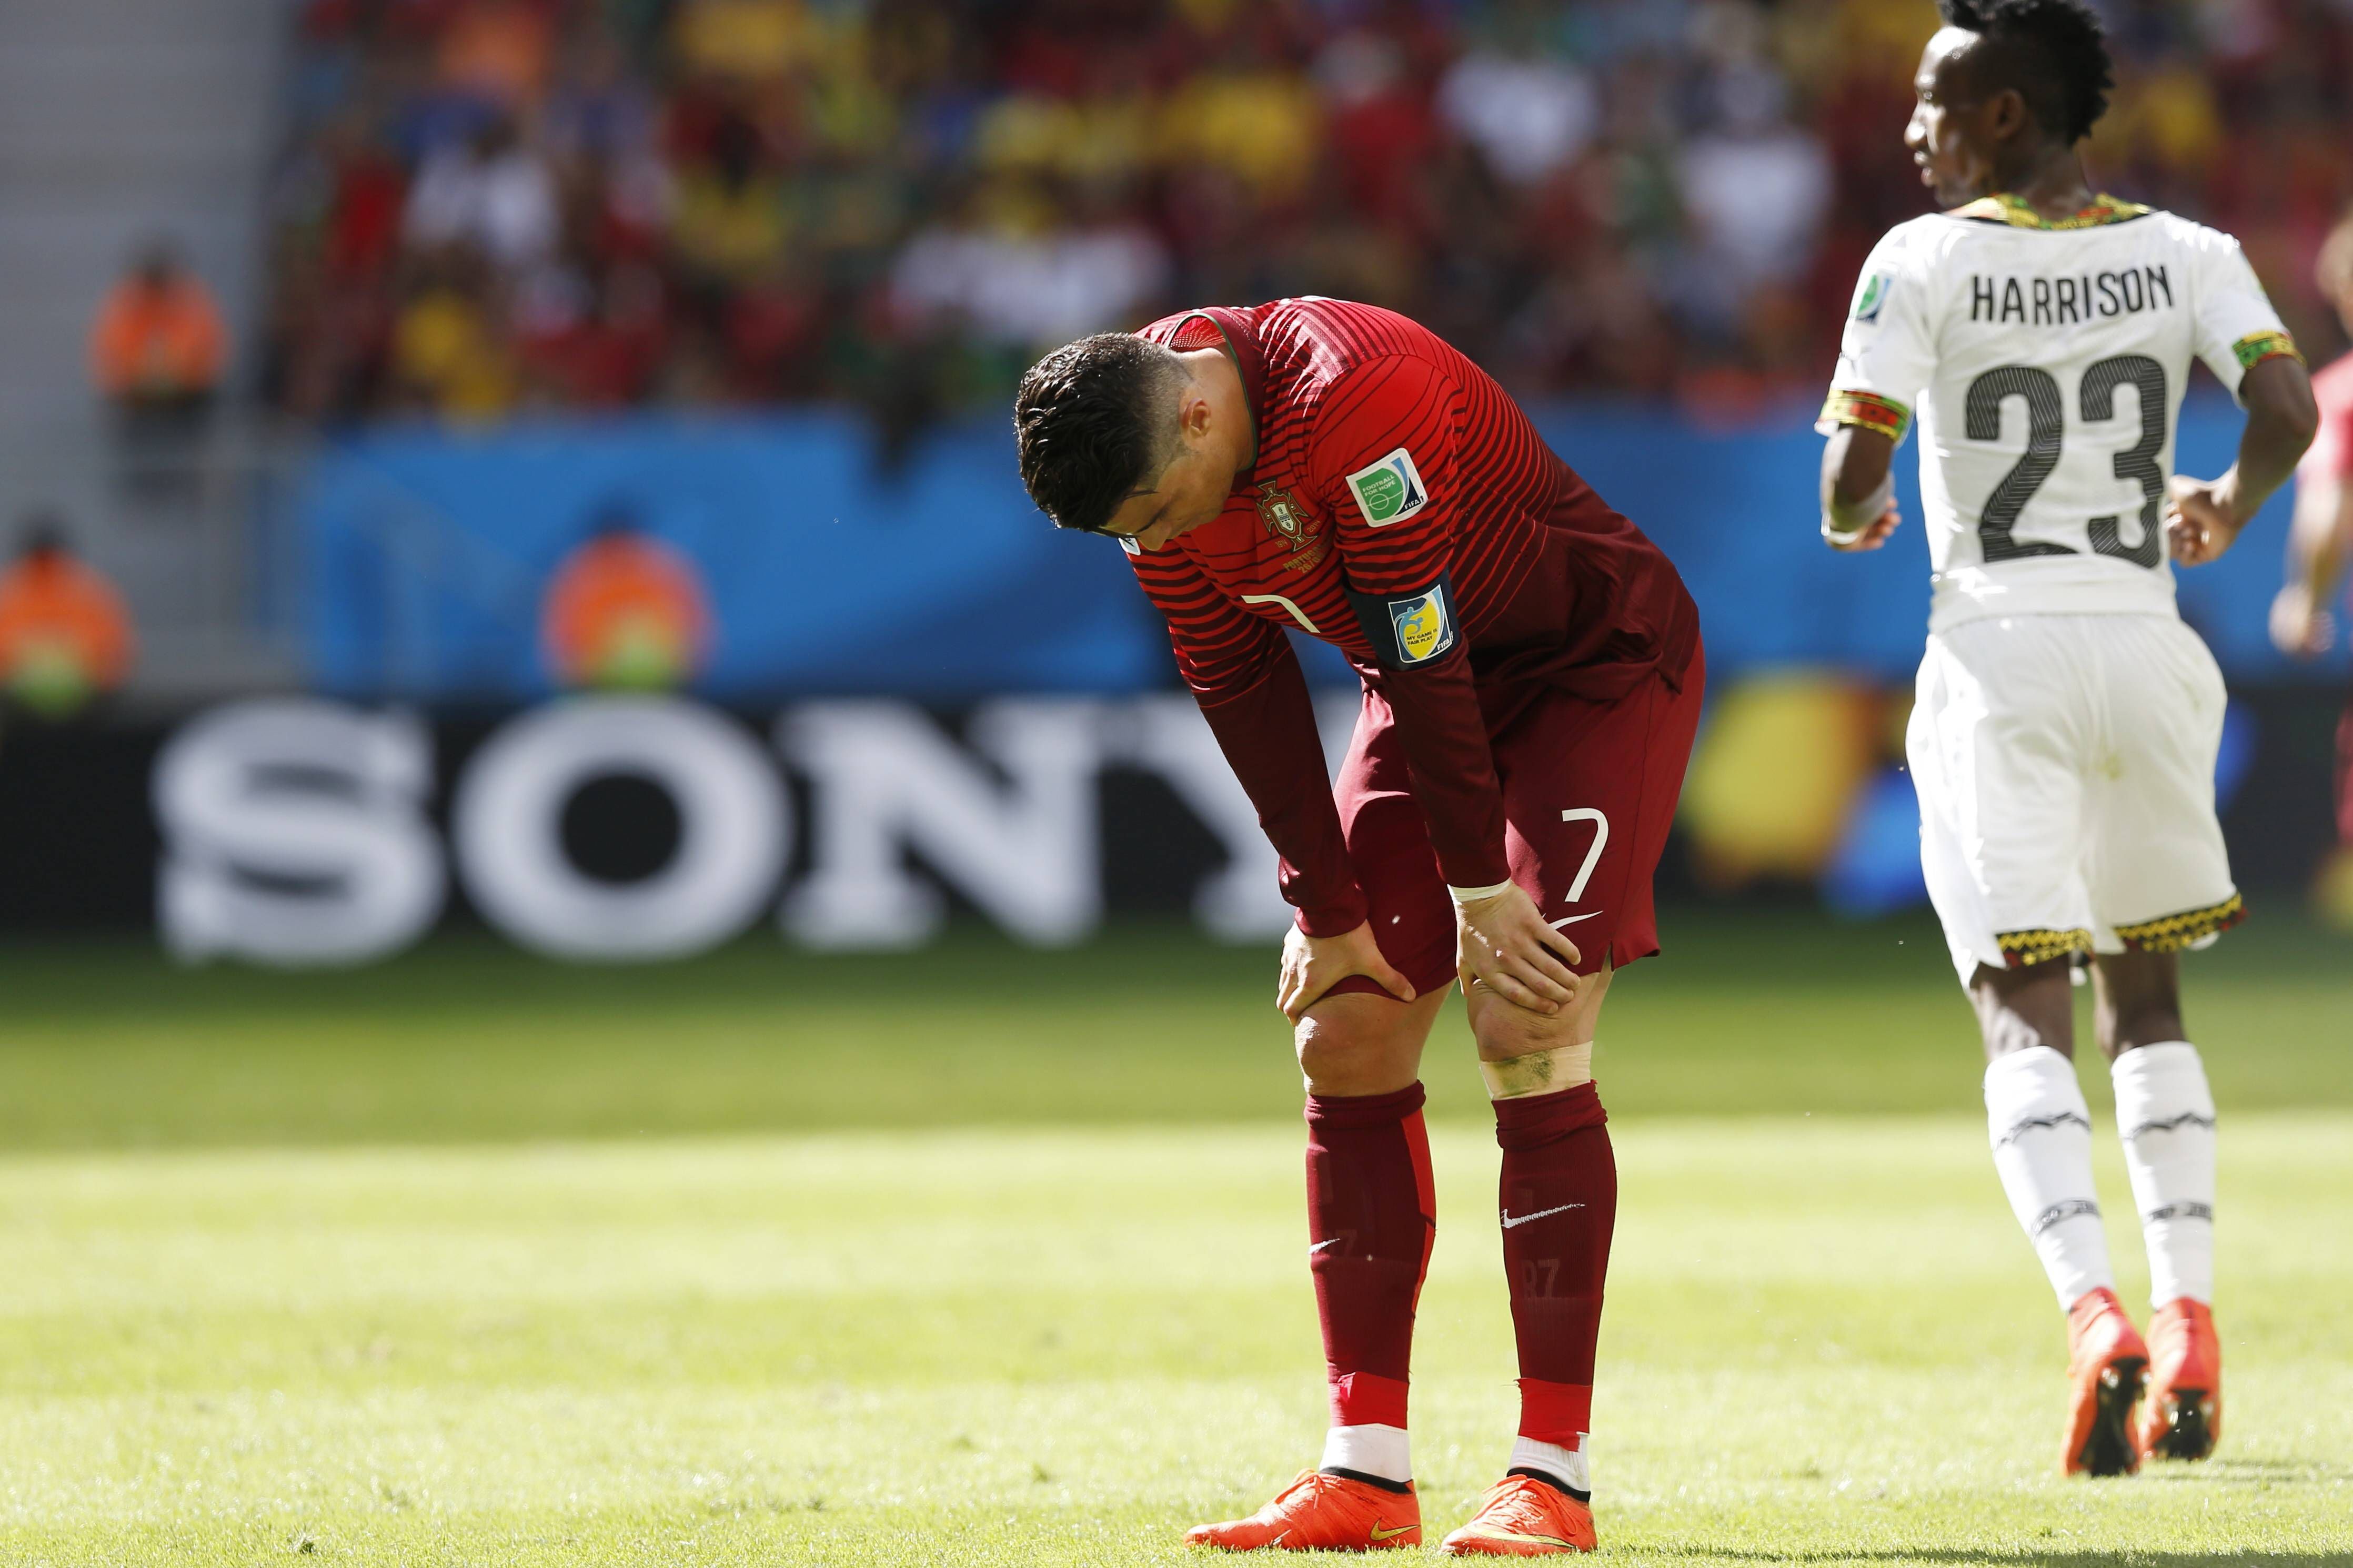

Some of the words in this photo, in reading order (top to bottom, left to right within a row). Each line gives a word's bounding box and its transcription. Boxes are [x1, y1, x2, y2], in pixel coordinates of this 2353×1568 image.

[1971, 265, 2173, 325] HARRISON
[1965, 355, 2166, 569] 23
[1362, 474, 1394, 492] FOOTBALL
[1379, 479, 1396, 491] HOPE
[1404, 499, 1420, 510] FIFA
[1437, 638, 1450, 651] FIFA
[1562, 807, 1609, 903] 7
